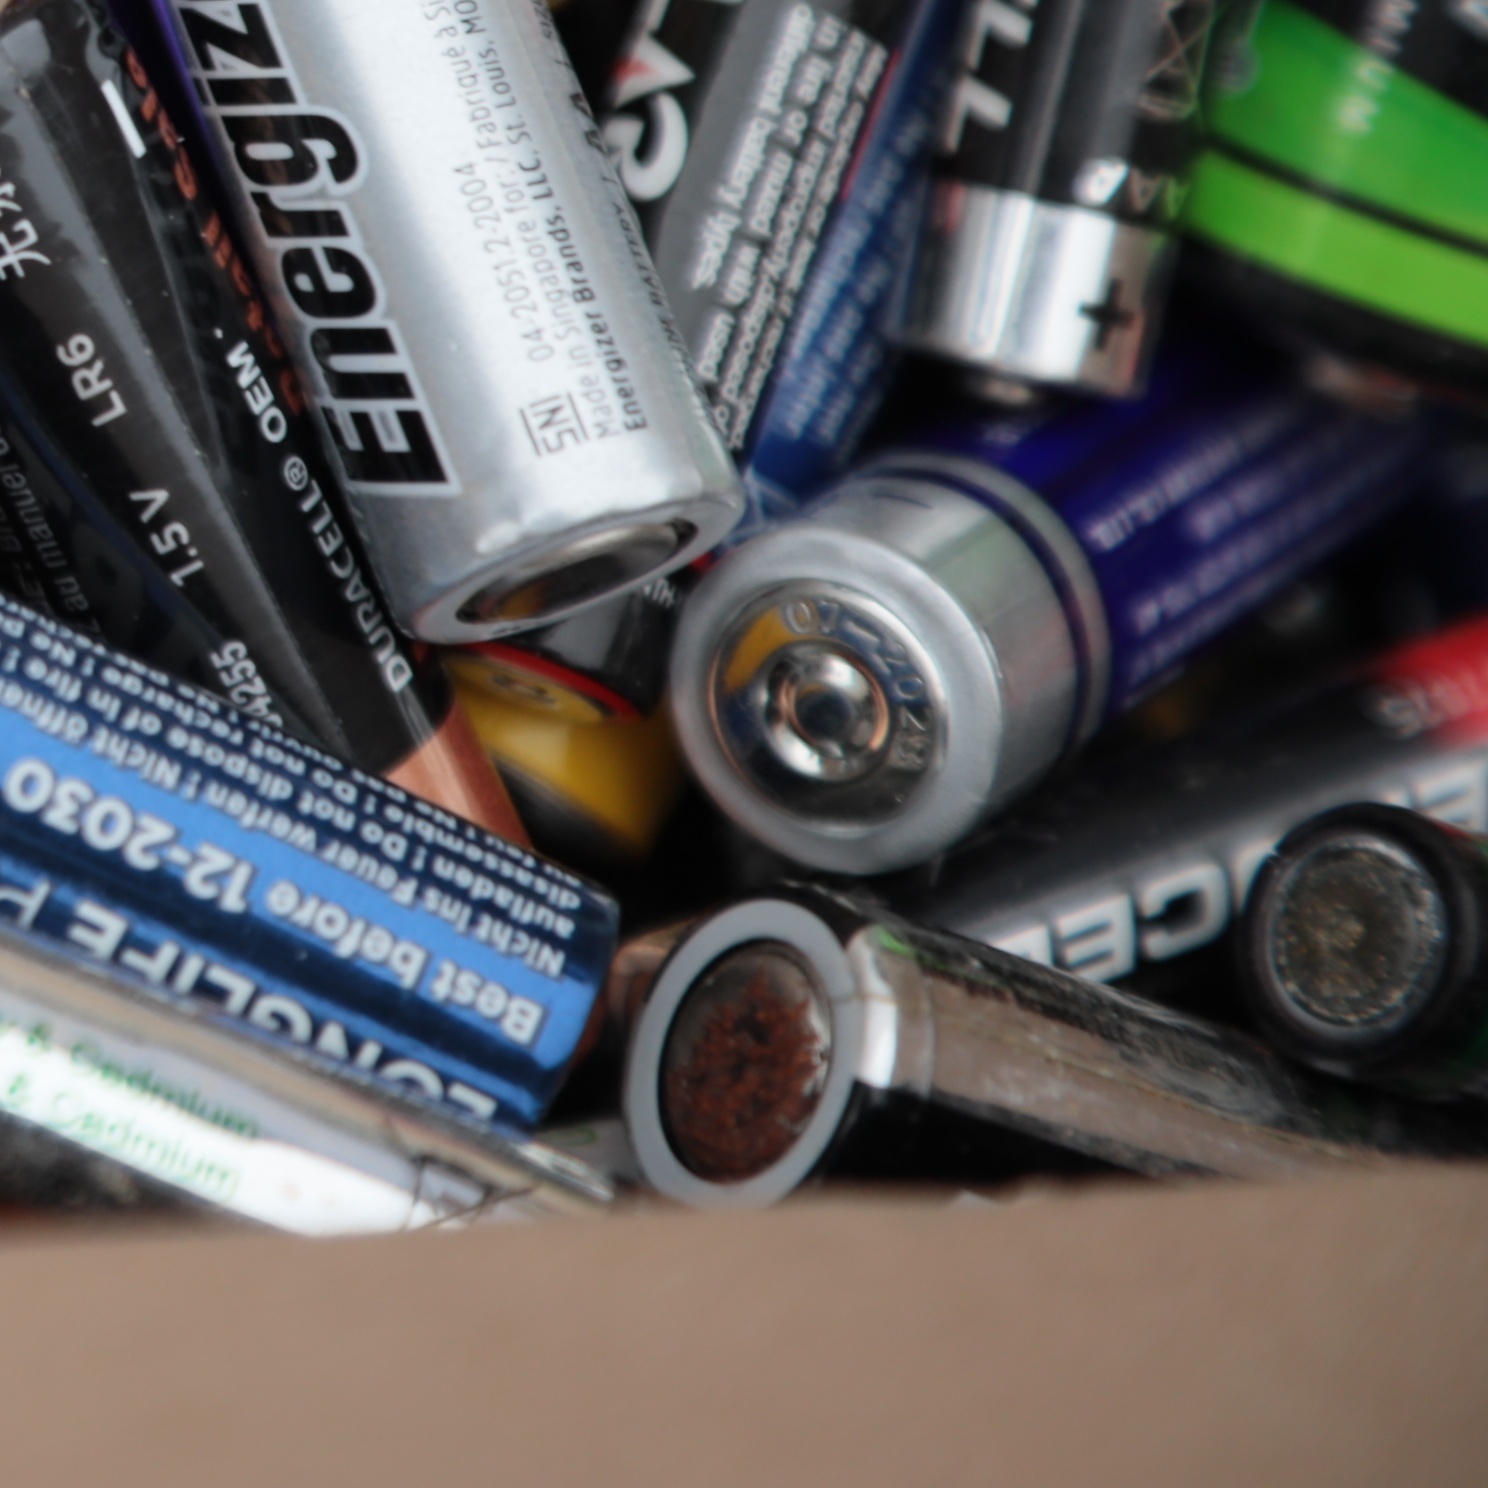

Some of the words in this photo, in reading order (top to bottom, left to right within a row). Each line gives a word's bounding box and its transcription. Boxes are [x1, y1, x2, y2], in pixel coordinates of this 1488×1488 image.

[436, 37, 507, 150] Fabriqué
[755, 0, 824, 114] different
[712, 112, 778, 209] battery
[745, 152, 799, 236] mixed
[513, 214, 586, 340] Singapore
[539, 202, 597, 304] Brands,
[718, 242, 764, 308] with
[54, 327, 129, 429] LR6
[222, 338, 294, 446] OEM
[560, 340, 594, 374] in
[578, 304, 650, 434] Energizer
[523, 390, 582, 457] SNI
[572, 370, 622, 442] Made
[128, 477, 178, 526] V
[149, 518, 209, 588] 1.5
[17, 649, 80, 699] fire
[88, 723, 184, 789] Nicht
[118, 698, 164, 740] of
[163, 719, 297, 804] dispose
[1, 758, 256, 916] 12-2030
[194, 774, 318, 854] werfen
[290, 786, 358, 838] not
[353, 816, 410, 862] Do
[315, 835, 419, 905] Feuer
[416, 885, 474, 933] ins
[424, 852, 577, 942] aufladen
[259, 882, 422, 982] before
[470, 913, 569, 980] Nicht
[428, 957, 544, 1045] Best
